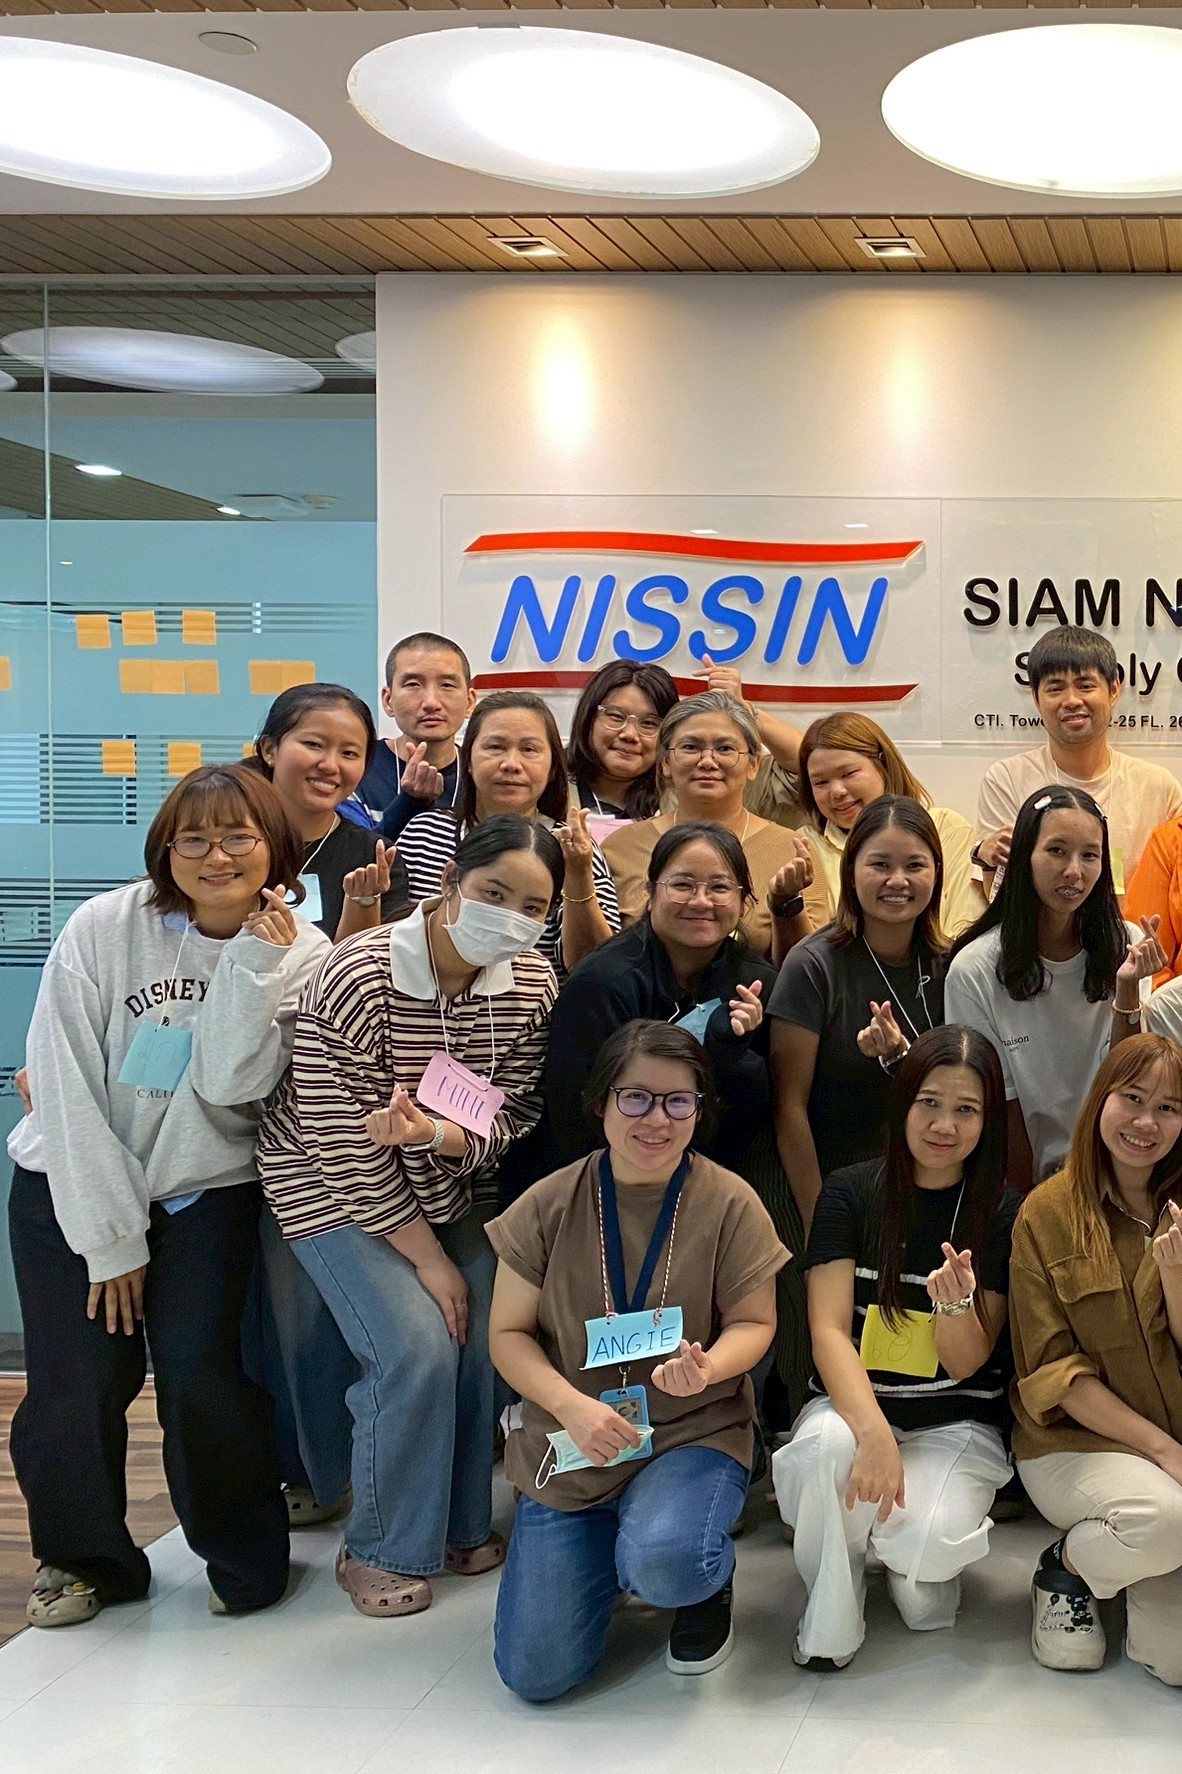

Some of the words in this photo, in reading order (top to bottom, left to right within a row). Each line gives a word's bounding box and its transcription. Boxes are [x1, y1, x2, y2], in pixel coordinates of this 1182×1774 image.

[490, 574, 889, 666] NISSIN
[963, 576, 1121, 627] SIAM
[1014, 652, 1162, 696] Sly
[974, 714, 1004, 728] CTI.
[1141, 715, 1163, 729] FL.
[124, 978, 210, 1018] DISNEY
[592, 1326, 677, 1364] ANGIE
